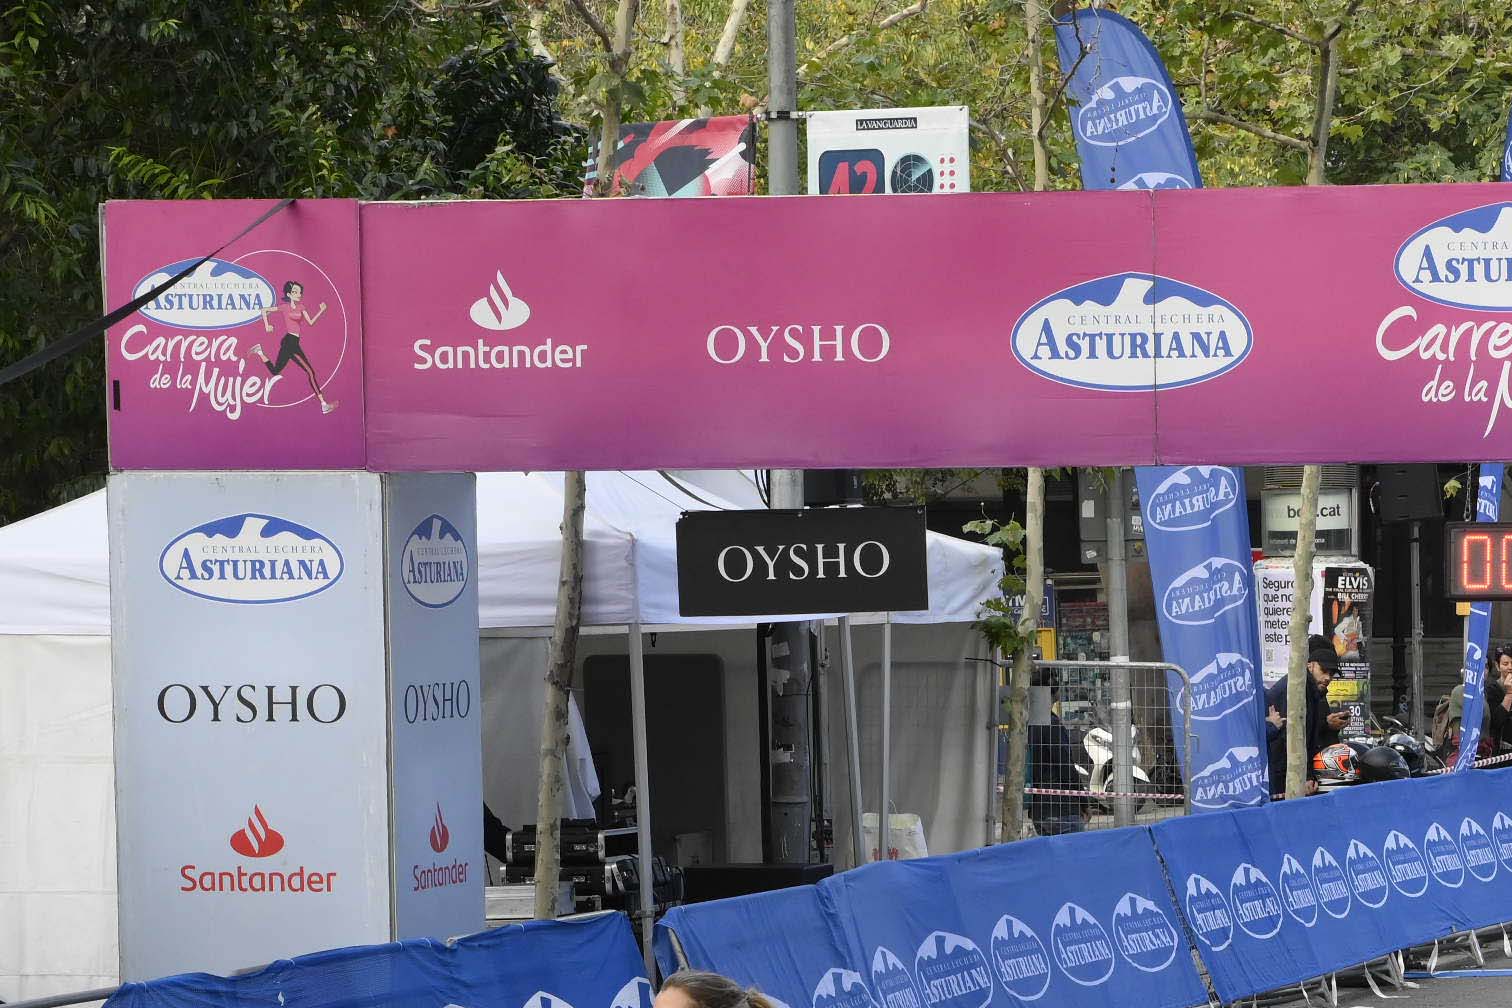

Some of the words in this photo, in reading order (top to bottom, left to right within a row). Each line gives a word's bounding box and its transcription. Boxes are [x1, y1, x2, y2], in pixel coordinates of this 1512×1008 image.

[171, 282, 211, 290] ENTRAL
[214, 282, 261, 290] LECHERA
[1067, 314, 1141, 326] CENTRAL
[1149, 313, 1226, 325] LECHERA
[120, 324, 239, 361] Carrera
[413, 339, 588, 369] Santander
[706, 323, 890, 364] OYSHO
[1030, 317, 1235, 361] ASTURIANA
[150, 362, 172, 389] de
[177, 361, 192, 389] la
[189, 358, 284, 420] Mujer
[1421, 364, 1455, 403] de
[1464, 361, 1488, 403] la
[174, 546, 330, 582] ASTURIANA
[201, 544, 259, 555] CENTRAL
[265, 544, 324, 554] LECHERA
[717, 541, 891, 582] OYSHO
[407, 549, 464, 585] ASTURIANA
[1338, 576, 1368, 589] ELVIS
[1263, 593, 1279, 605] que
[1264, 605, 1295, 618] quiere
[1265, 633, 1282, 642] este
[157, 683, 347, 724] OYSHO
[403, 680, 471, 725] OYSHO
[180, 864, 337, 893] Santander
[412, 859, 469, 892] Santander
[995, 950, 1048, 982] ASTURIANA
[1057, 937, 1112, 968] ASTURIANA
[920, 965, 990, 1004] ASTURIANA
